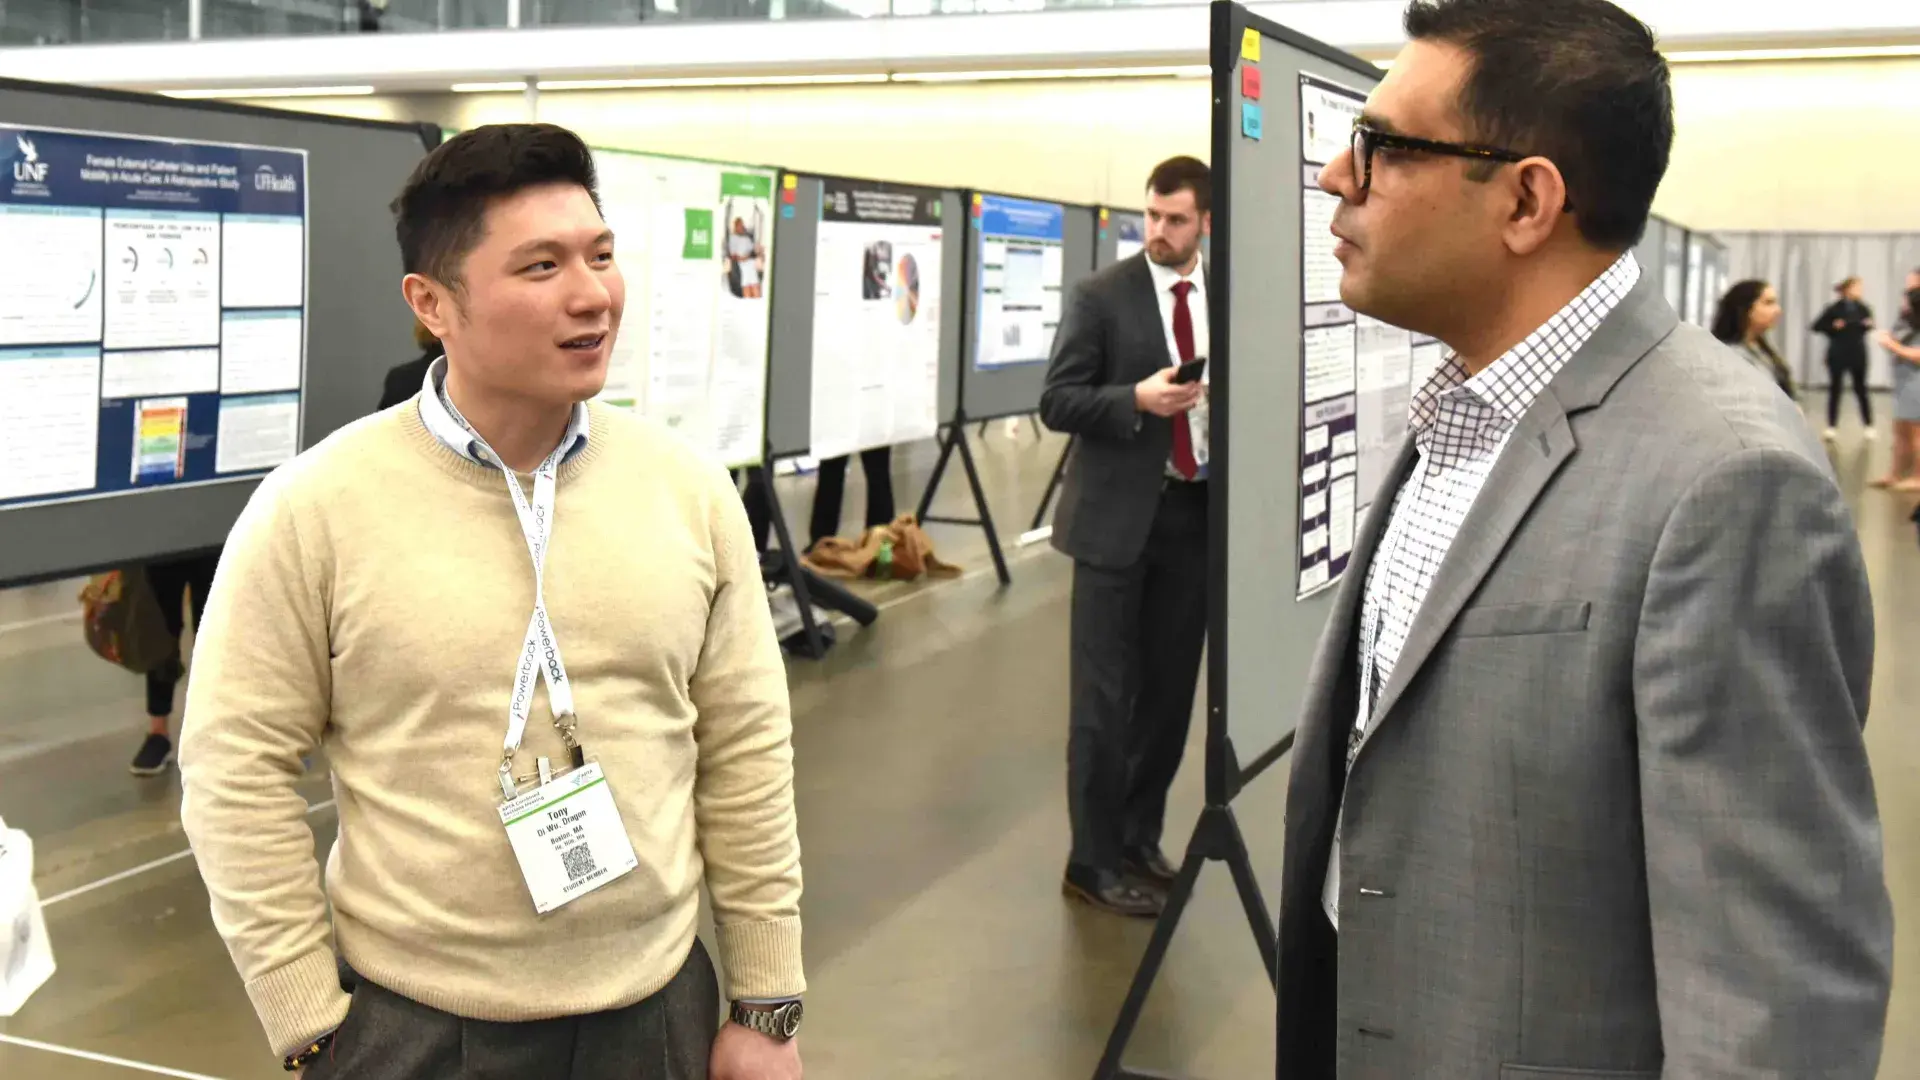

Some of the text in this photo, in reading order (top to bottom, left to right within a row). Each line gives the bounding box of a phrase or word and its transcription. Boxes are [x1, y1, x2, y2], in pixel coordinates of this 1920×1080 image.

[13, 161, 49, 181] UNF
[86, 153, 116, 168] Female
[116, 156, 148, 170] External
[149, 159, 180, 173] Catheter
[197, 164, 209, 174] and
[211, 163, 237, 175] Patient
[80, 168, 110, 183] Mobility
[120, 171, 142, 184] Acute
[171, 175, 218, 188] Retrospective
[219, 178, 240, 191] Study
[537, 611, 563, 685] Powerback
[513, 639, 536, 711] Powerback
[503, 805, 524, 817] Sections
[525, 796, 545, 807] Meeting
[516, 791, 540, 805] Combined
[547, 807, 568, 821] Tony
[562, 810, 587, 825] Dragon
[550, 824, 583, 844] Boston, MA
[562, 867, 609, 893] STUDENT MEMBER
